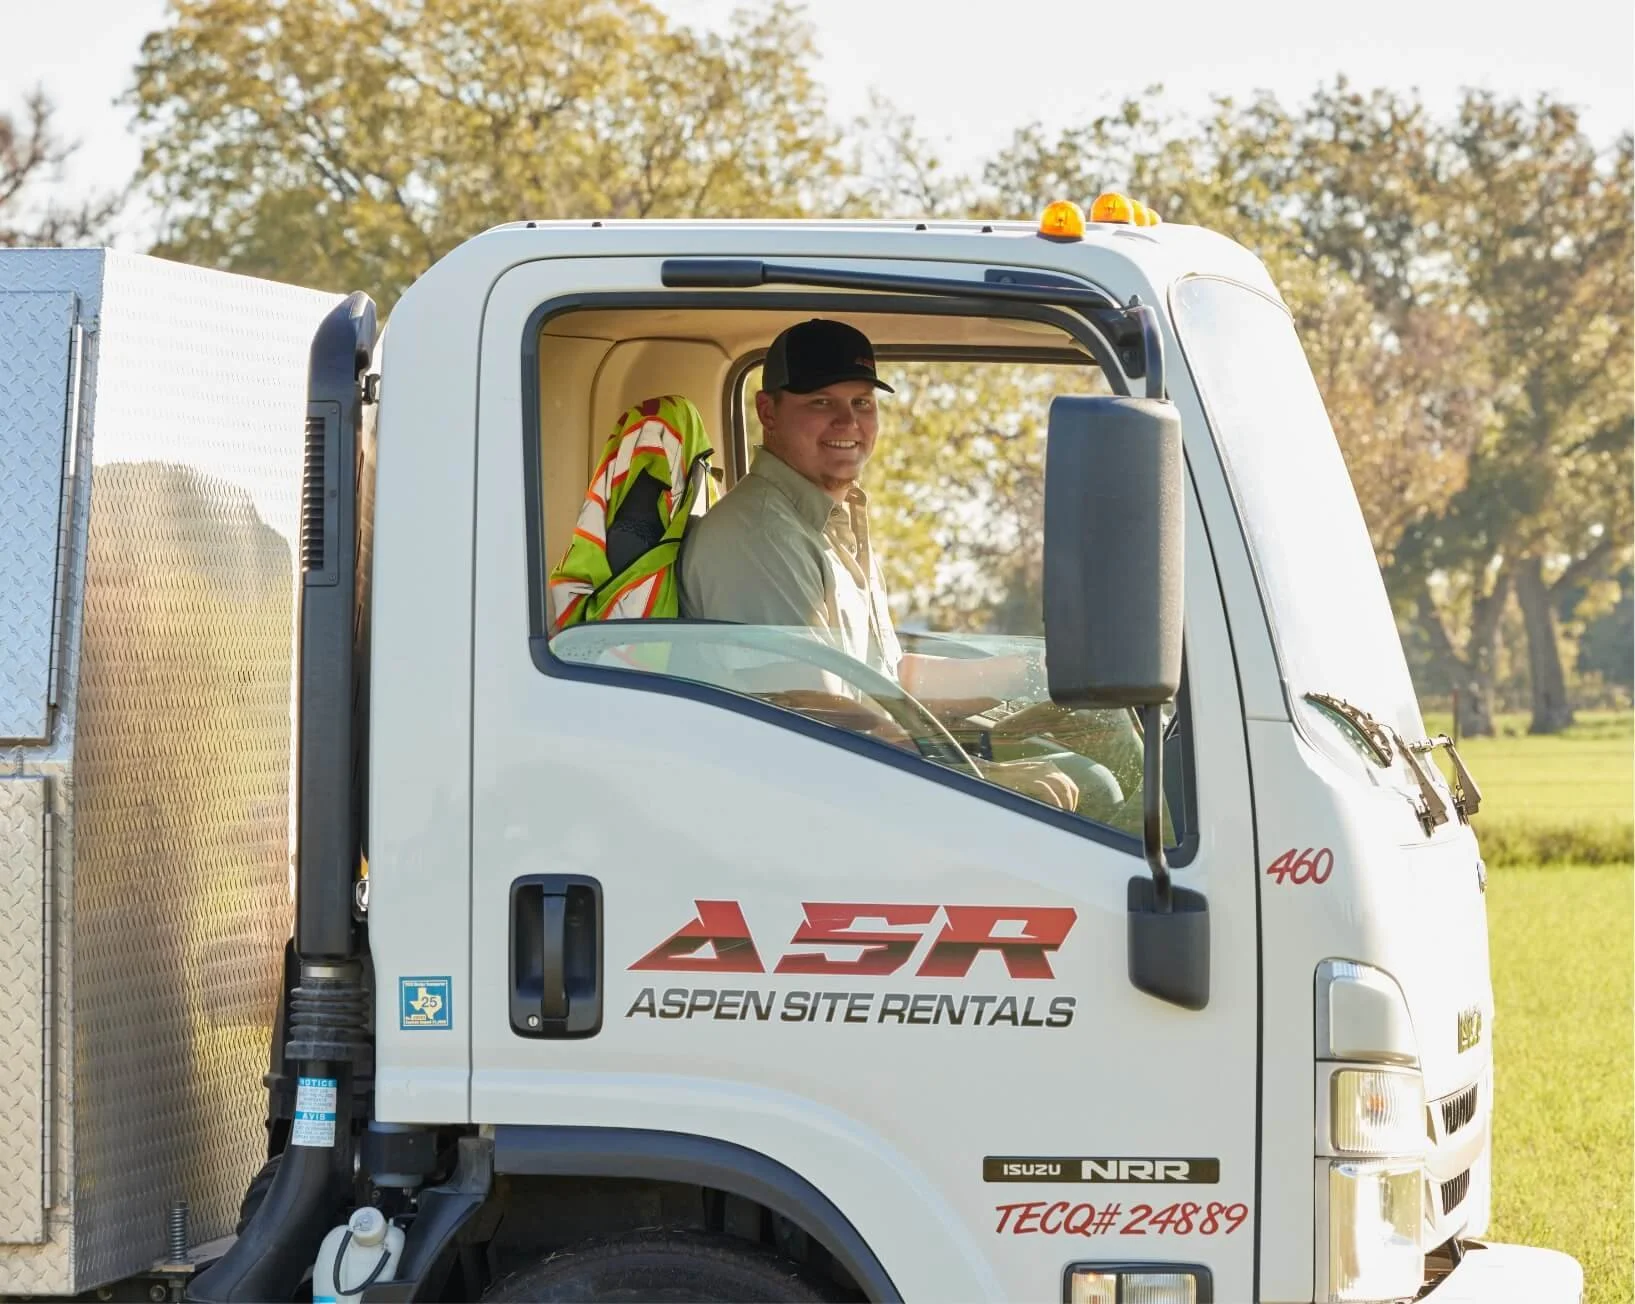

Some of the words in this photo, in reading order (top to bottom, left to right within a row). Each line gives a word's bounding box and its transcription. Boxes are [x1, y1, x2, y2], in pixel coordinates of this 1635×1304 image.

[1266, 847, 1334, 885] 460
[625, 898, 1078, 980] ASR
[421, 996, 438, 1008] 25
[624, 987, 776, 1021] ASPEN
[780, 990, 879, 1024] SITE
[877, 993, 1077, 1028] RENTALS
[299, 1078, 334, 1087] NOTICE
[302, 1112, 326, 1121] AVIS
[1003, 1163, 1061, 1176] ISUZU
[1081, 1160, 1190, 1180] NRR
[1120, 1201, 1249, 1235] 24889
